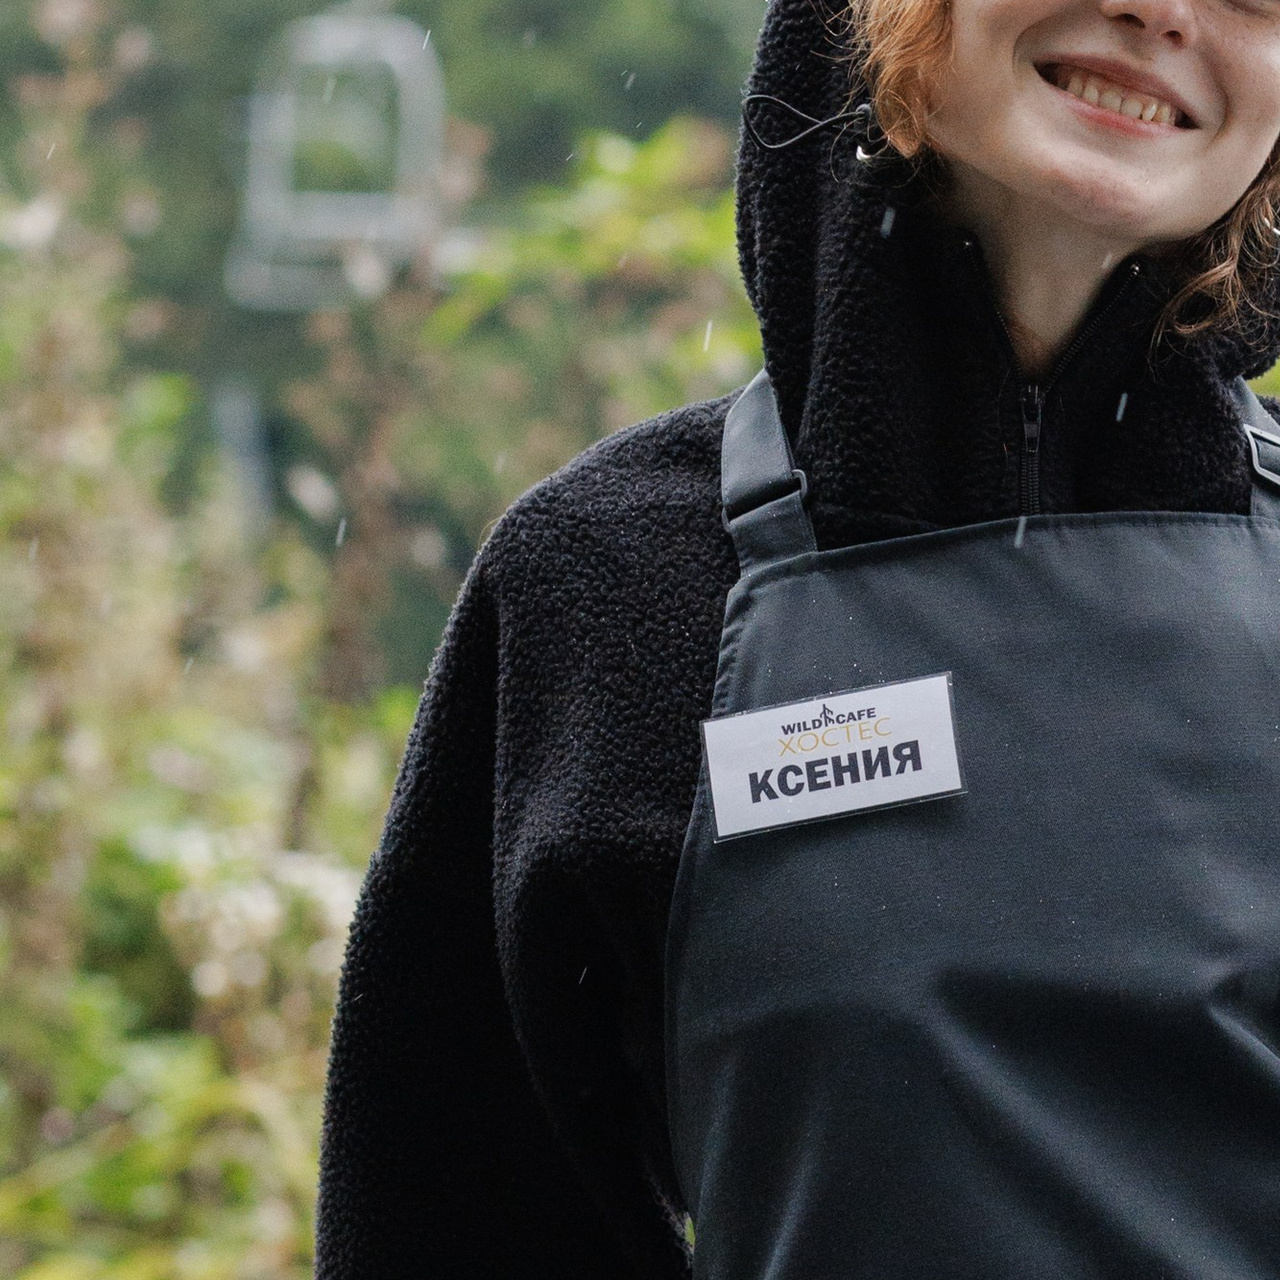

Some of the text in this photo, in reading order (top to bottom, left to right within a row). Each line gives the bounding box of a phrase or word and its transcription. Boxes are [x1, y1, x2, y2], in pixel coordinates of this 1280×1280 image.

[778, 716, 893, 757] ХОСТЕС
[781, 706, 876, 736] WILD CAFE
[748, 739, 923, 804] КСЕНИЯ
